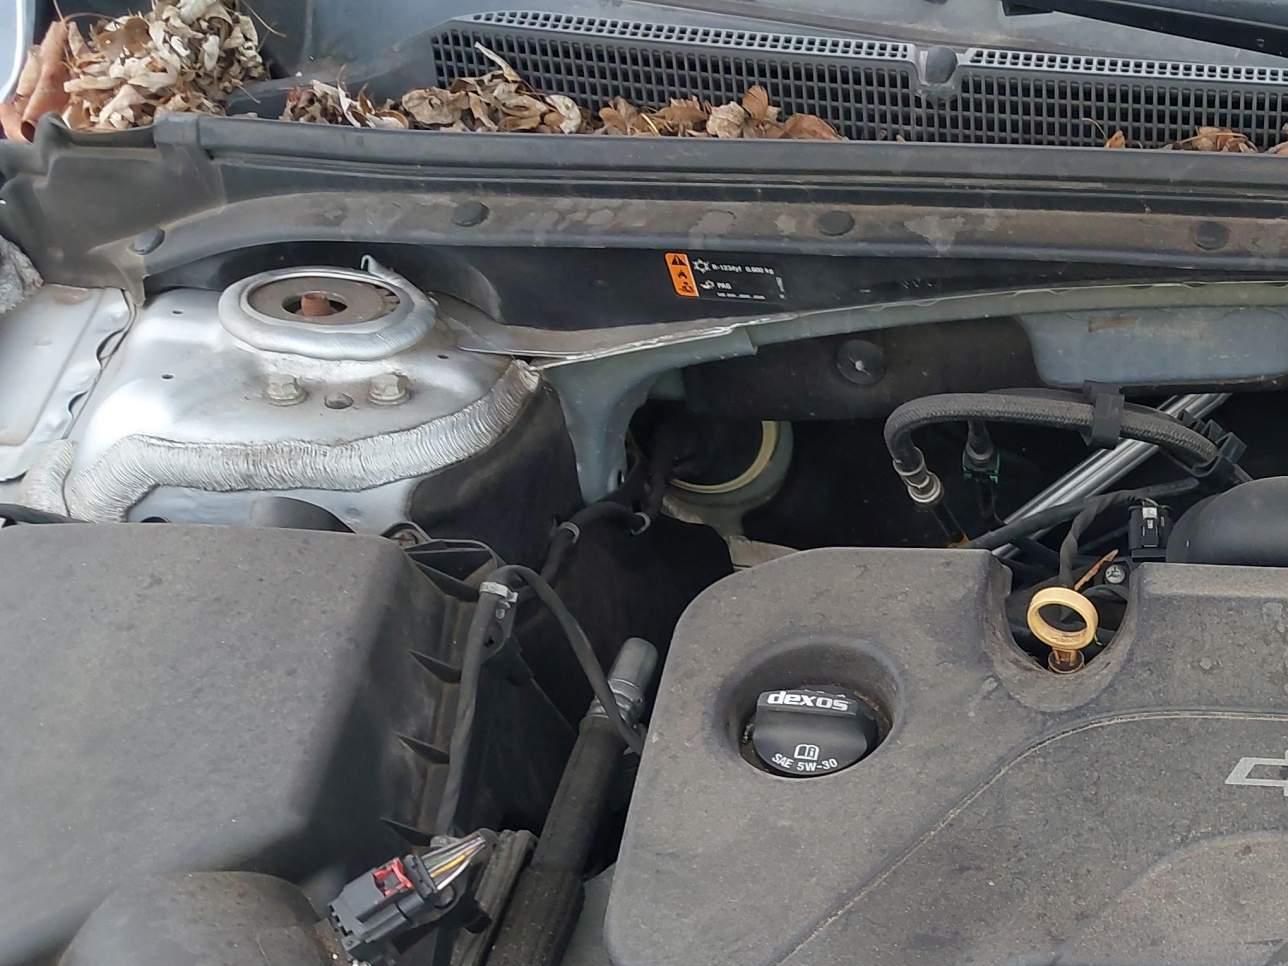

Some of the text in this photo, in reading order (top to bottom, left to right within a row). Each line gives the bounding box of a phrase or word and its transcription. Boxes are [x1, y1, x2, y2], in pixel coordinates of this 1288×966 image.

[767, 691, 850, 711] dexos
[771, 753, 838, 771] SAE 5W-30
